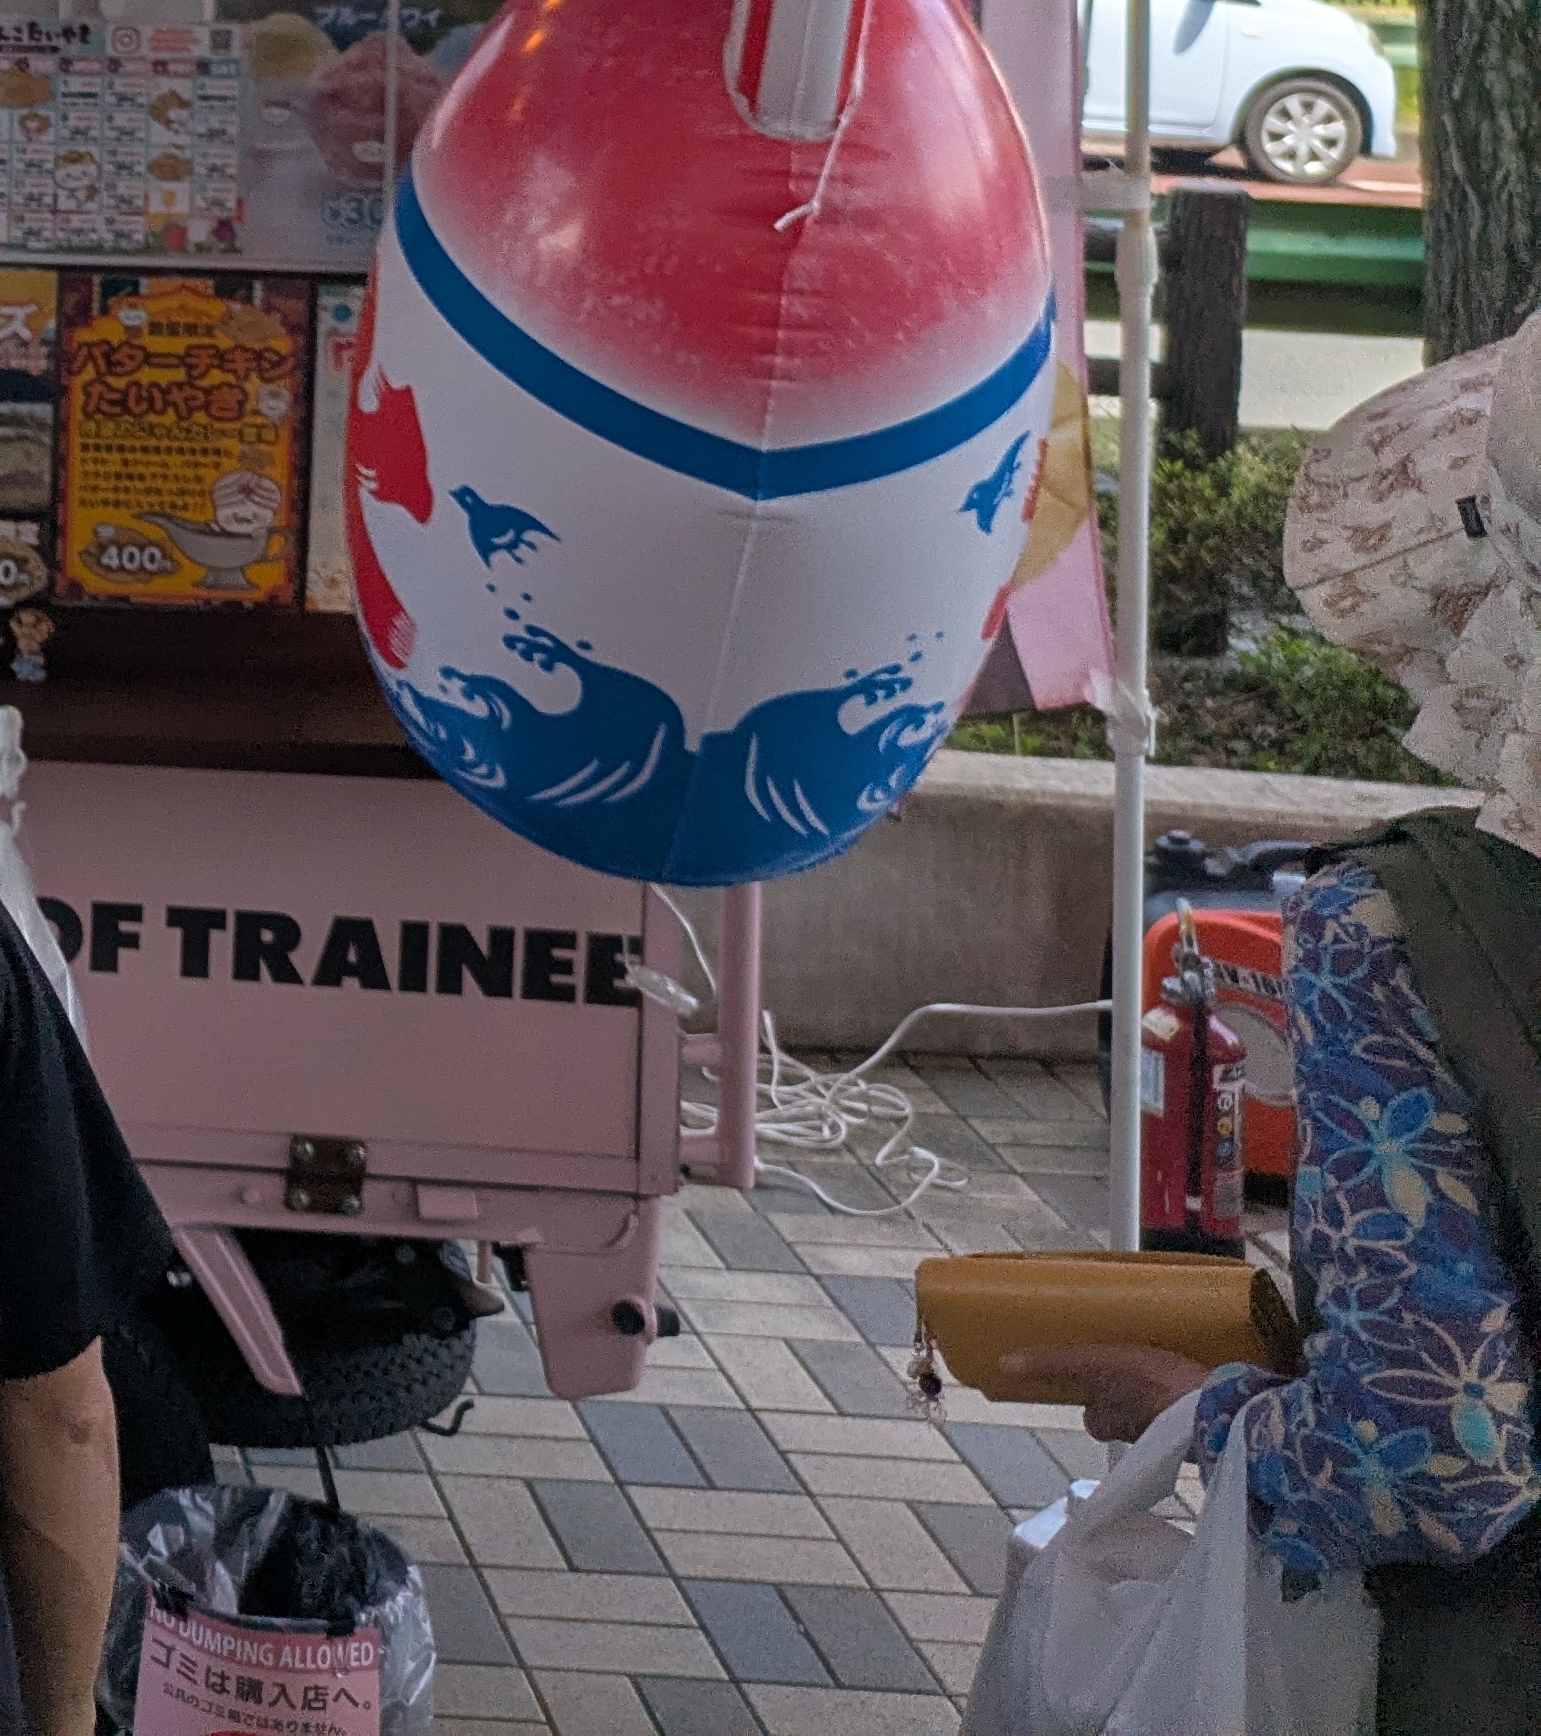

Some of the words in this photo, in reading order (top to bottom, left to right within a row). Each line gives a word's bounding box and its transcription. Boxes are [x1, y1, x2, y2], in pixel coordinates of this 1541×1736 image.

[315, 5, 444, 29] ブルーワイ
[66, 339, 293, 384] バターチキン
[82, 379, 248, 421] たいやき
[166, 904, 645, 1007] TRAINEE
[177, 1619, 274, 1666] DUMPING
[279, 1640, 375, 1671] ALLOWED
[149, 1634, 372, 1712] ゴミは購入店へ。
